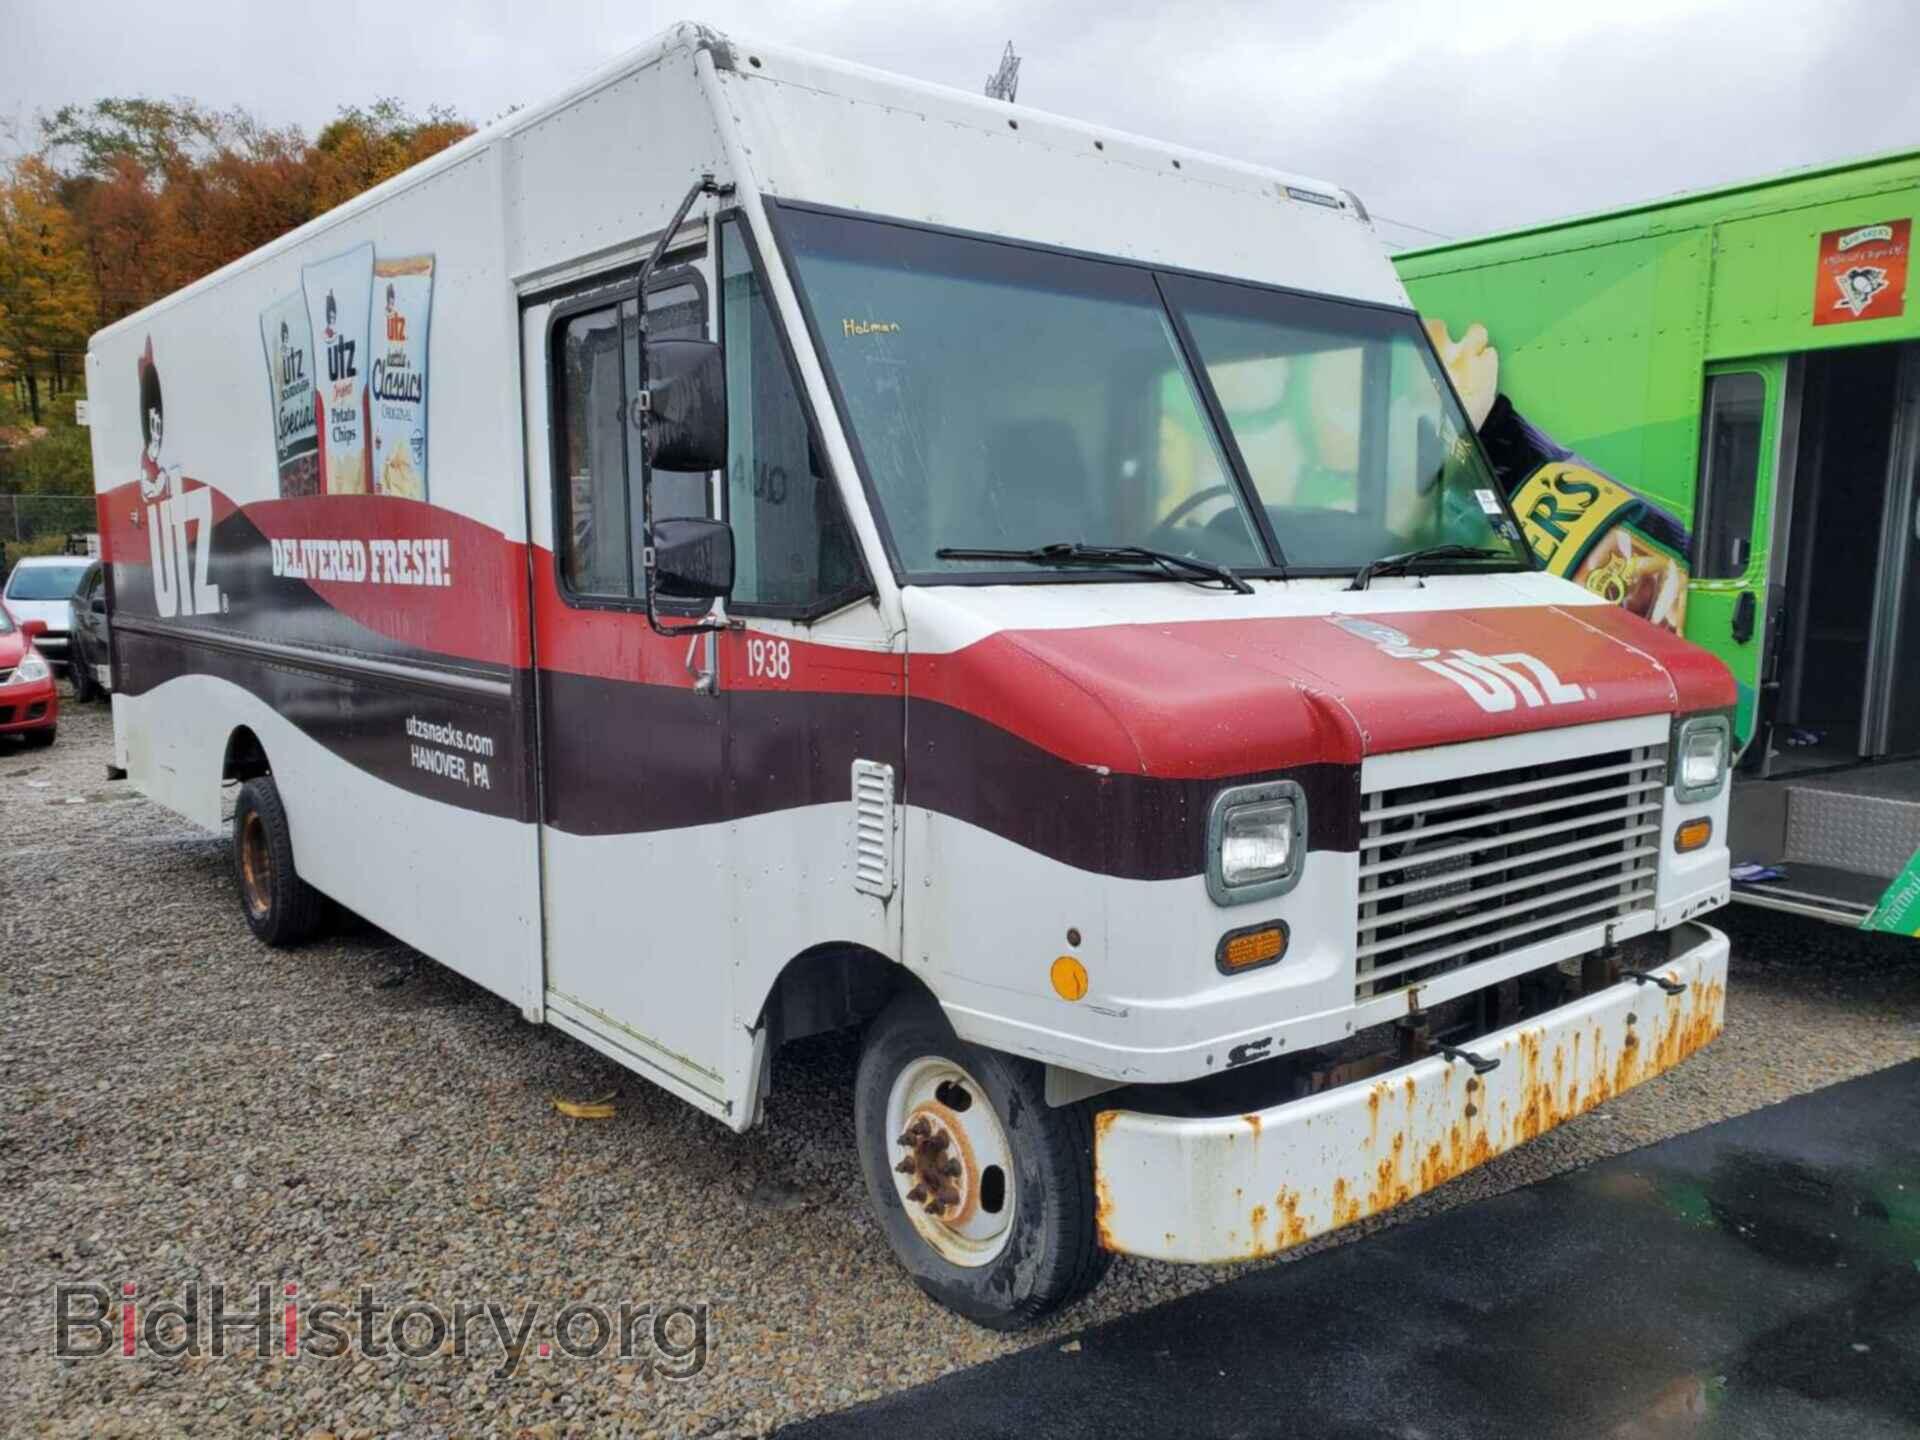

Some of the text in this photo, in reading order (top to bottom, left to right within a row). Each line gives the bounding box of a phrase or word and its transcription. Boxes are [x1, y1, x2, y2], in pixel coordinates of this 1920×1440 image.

[332, 426, 356, 446] Chips
[271, 539, 451, 586] DELIVERED FRESH!
[747, 639, 790, 680] 1938
[406, 715, 494, 757] utzsnacks.com
[411, 745, 490, 790] HANOVER, PA
